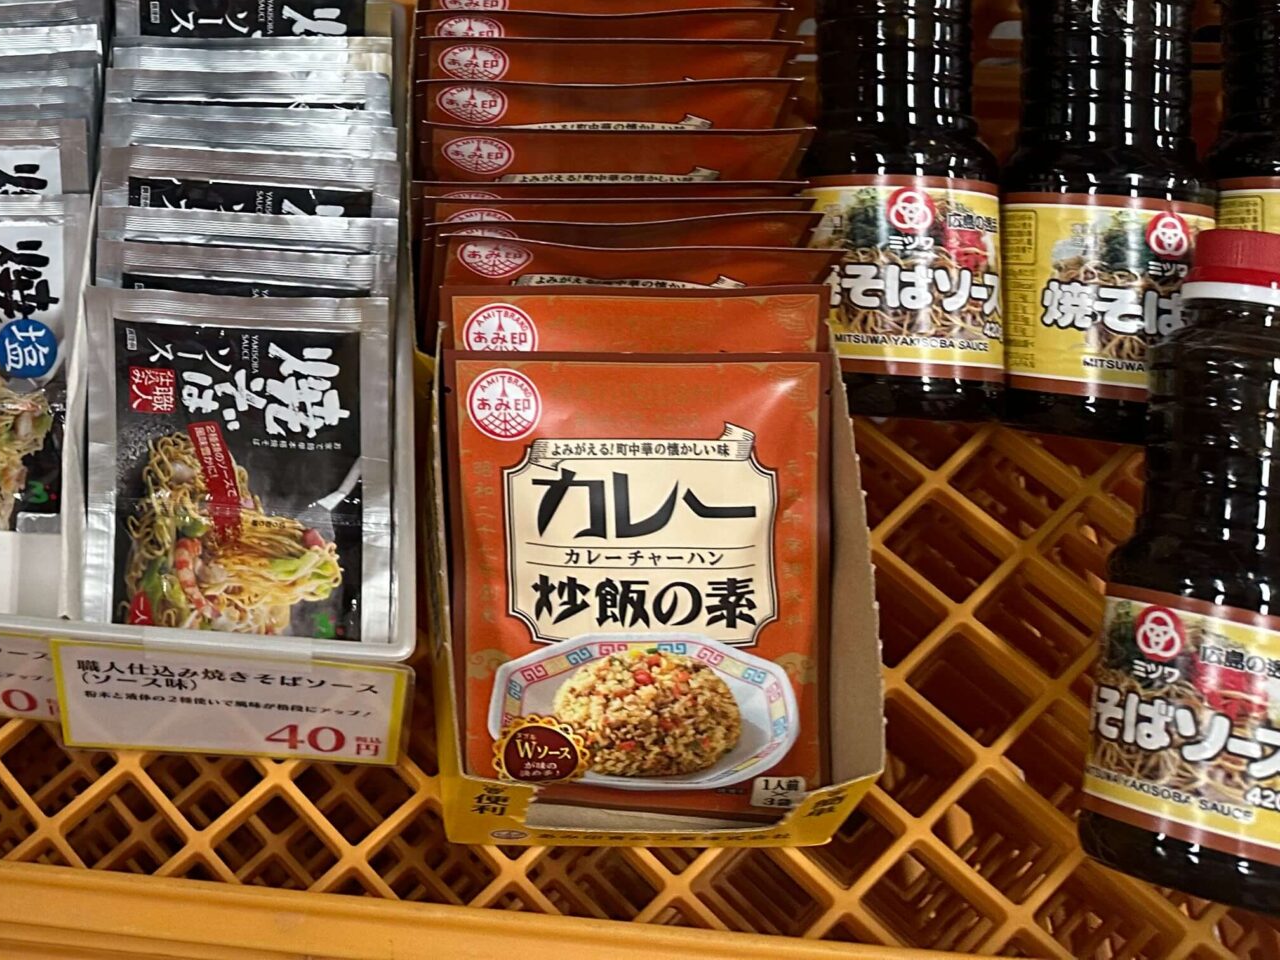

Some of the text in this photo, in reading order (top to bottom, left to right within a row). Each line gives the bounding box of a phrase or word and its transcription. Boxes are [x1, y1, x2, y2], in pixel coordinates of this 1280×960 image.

[448, 58, 499, 69] あみ印
[451, 149, 503, 160] あみ印
[888, 235, 935, 250] ミツワ
[467, 249, 523, 261] あみ印
[1147, 261, 1189, 277] ミツワ
[4, 324, 51, 372] 塩
[241, 334, 249, 360] SAUCE
[473, 331, 528, 345] あみ印
[835, 333, 989, 352] MITSUWA YAKISOBA SAUCE
[147, 338, 232, 371] ソース
[251, 334, 259, 374] YAKISOBA
[1082, 357, 1145, 372] MITSUWA
[131, 369, 175, 386] 仕込み
[131, 386, 175, 412] 職人
[477, 397, 531, 412] あみ印
[551, 441, 730, 458] よみがえる!町中華の懐かしい味
[531, 471, 756, 539] カレー
[564, 548, 724, 567] カレーチャーハン
[532, 574, 756, 629] 炒飯の素
[76, 658, 380, 695] 職人仕込み焼きそばソース
[1131, 659, 1181, 683] ミツワ
[264, 723, 346, 753] 40
[355, 744, 380, 757] 円
[1089, 685, 1280, 778] そばソース
[515, 739, 572, 760] Wソース
[762, 779, 801, 791] 1人前
[1122, 778, 1191, 804] YAKISOBA
[1199, 799, 1254, 820] SAUCE
